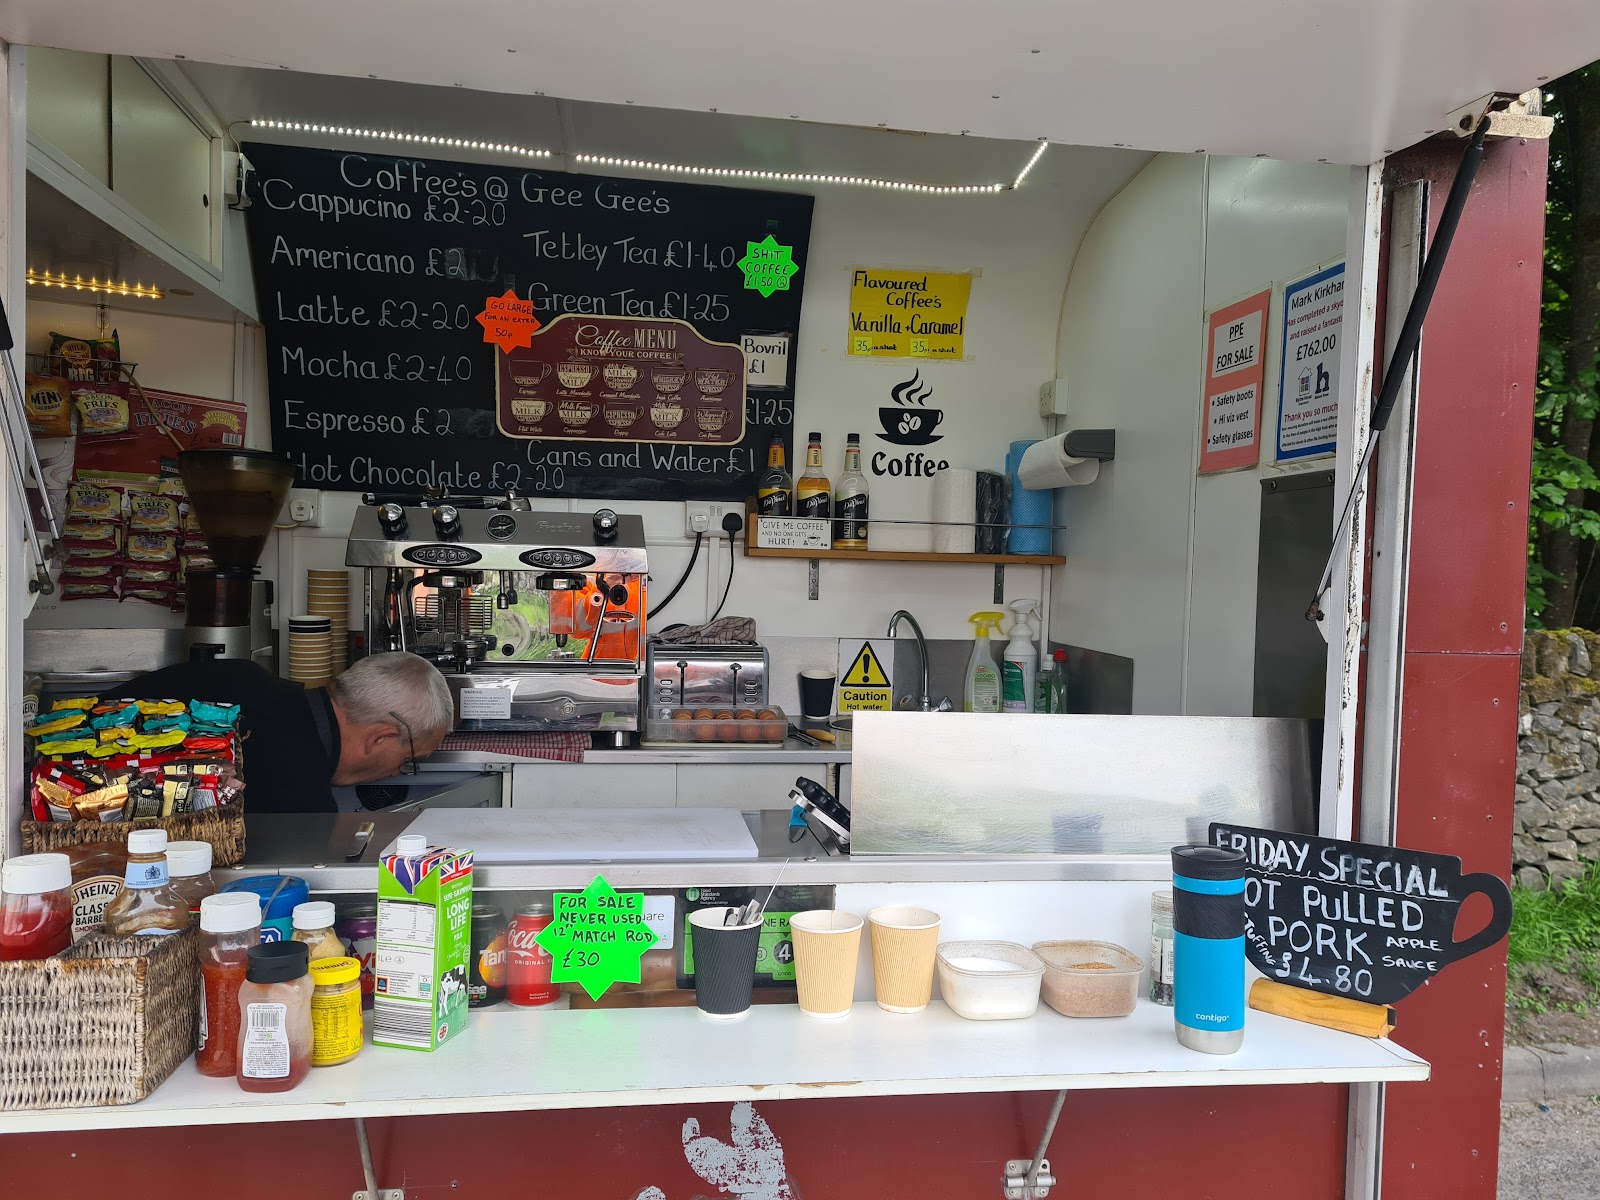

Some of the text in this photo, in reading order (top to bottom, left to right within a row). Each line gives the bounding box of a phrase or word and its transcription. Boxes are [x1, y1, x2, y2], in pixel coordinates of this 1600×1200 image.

[340, 154, 670, 214] Coffee's @ Gee Gee's
[263, 178, 411, 222] Cappucino
[271, 235, 465, 278] Americano £2
[523, 230, 607, 271] Tetley
[613, 237, 658, 266] Tea
[752, 248, 784, 260] SHIT
[746, 262, 790, 275] COFFEE
[854, 270, 928, 292] Flavoured
[277, 290, 371, 325] Latte
[490, 301, 532, 315] GO LARGE
[527, 282, 606, 315] Green
[611, 288, 655, 318] Tea
[886, 291, 942, 309] Coffee's
[1291, 294, 1312, 311] Mark
[852, 312, 963, 336] Vanilla Caramel
[1286, 315, 1296, 327] Has
[1297, 305, 1326, 325] completed
[495, 327, 513, 340] 50p
[575, 323, 677, 354] Coffee MENU
[1229, 322, 1244, 339] PPE
[1289, 331, 1300, 341] and
[1301, 325, 1316, 337] raised
[580, 348, 672, 359] KNOW YOUR COFFEE
[744, 338, 786, 355] Bovril
[1296, 334, 1336, 362] £762.00
[282, 346, 379, 381] Mocha
[749, 359, 765, 373] £1
[1216, 345, 1254, 370] FOR SALE
[68, 367, 95, 381] BIG
[83, 401, 119, 410] FRIES
[1216, 389, 1254, 407] Safety boots
[284, 400, 454, 438] Espresso £2
[516, 407, 540, 415] MILK
[562, 410, 586, 418] MILK
[1218, 410, 1249, 425] Hi viz vest
[1284, 402, 1338, 423] Thank you so much
[1212, 428, 1254, 445] Safety glasses
[527, 440, 755, 473] Cans and Water £1
[287, 452, 341, 482] Hot
[350, 456, 482, 488] Chocolate
[137, 502, 170, 510] FRIES
[762, 521, 824, 531] GIVE ME COFFEE
[768, 538, 795, 546] HURT!
[843, 691, 887, 701] Caution
[1215, 828, 1449, 898] FRIDAY SPECIAL
[79, 884, 117, 900] HEINZ
[446, 898, 470, 920] LONG
[559, 895, 636, 909] FOR SALE
[1244, 877, 1425, 932] OT PULLED
[450, 912, 467, 931] LIFE
[559, 912, 643, 926] NEVER USED
[572, 930, 616, 943] MATCH
[626, 930, 652, 943] ROD
[1244, 911, 1277, 966] TUFFING
[1268, 915, 1374, 966] PORK
[1386, 935, 1444, 952] APPLE
[562, 948, 600, 969] £30
[778, 943, 791, 961] 4
[1381, 954, 1438, 972] SAUCE
[1196, 1013, 1229, 1023] contigo
